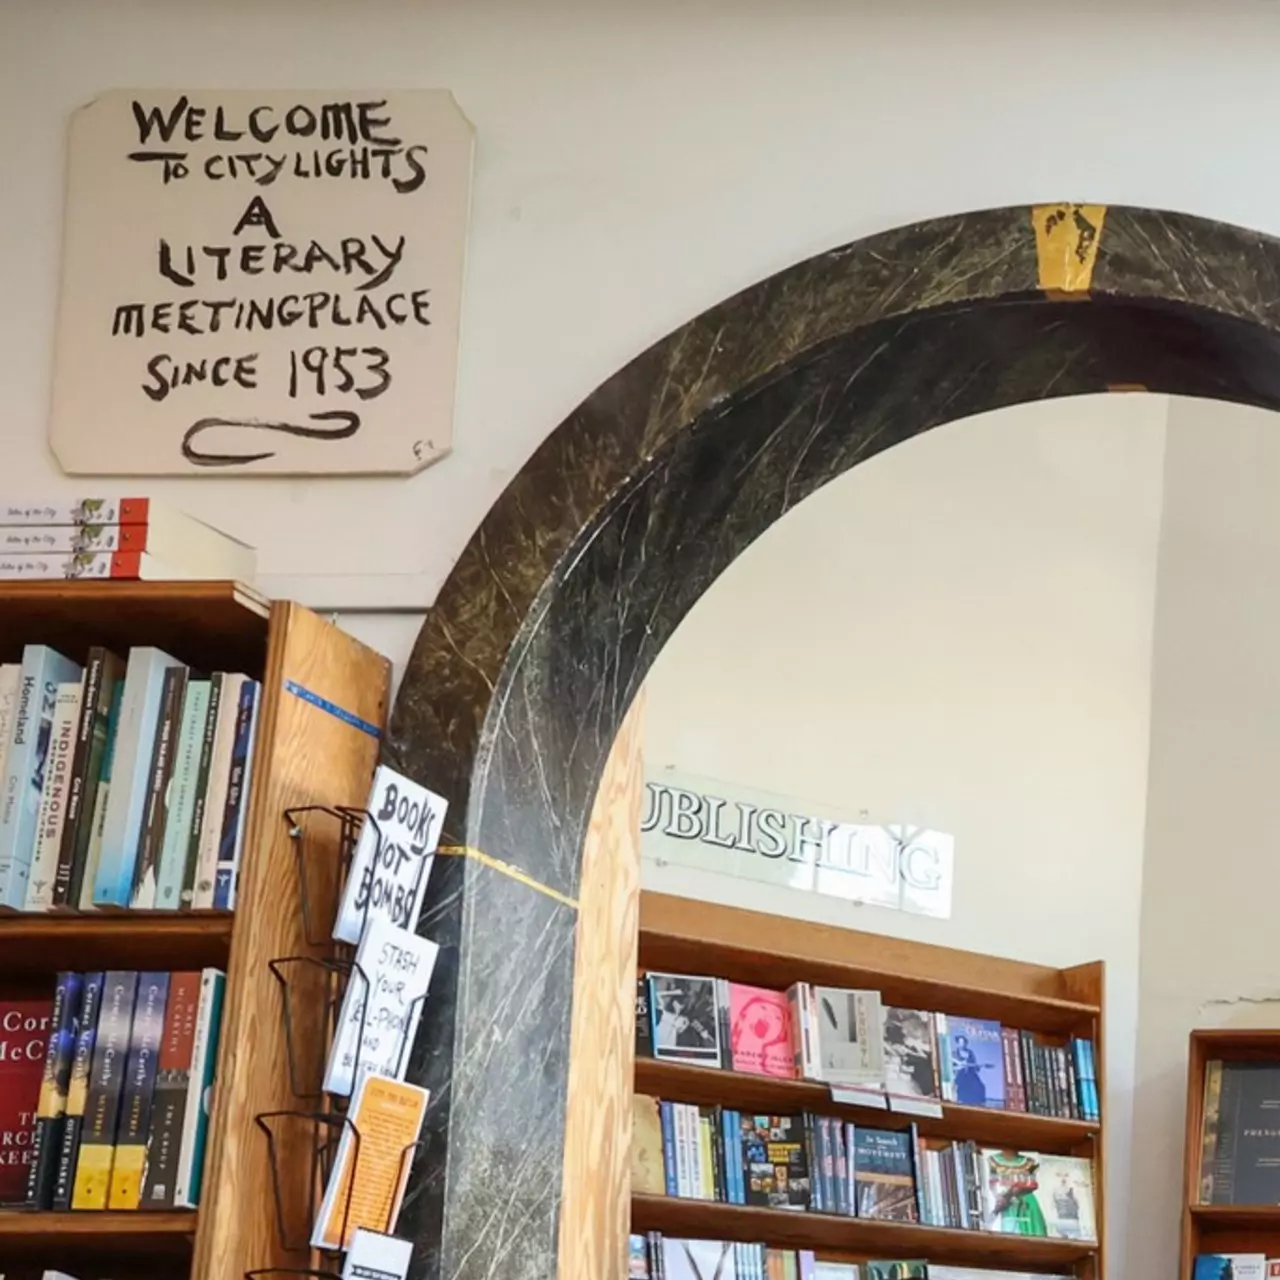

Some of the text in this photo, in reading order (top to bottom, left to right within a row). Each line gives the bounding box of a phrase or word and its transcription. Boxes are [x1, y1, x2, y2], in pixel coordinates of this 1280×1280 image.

[132, 97, 400, 145] WELCOME
[234, 196, 280, 237] A
[159, 234, 405, 289] LITERARY
[143, 347, 391, 400] SINCE 1953
[15, 676, 35, 745] Homeland
[47, 720, 71, 838] INDIGENOUS
[378, 783, 436, 856] BOOKS
[355, 867, 416, 929] BOMBS
[377, 942, 420, 975] STASH
